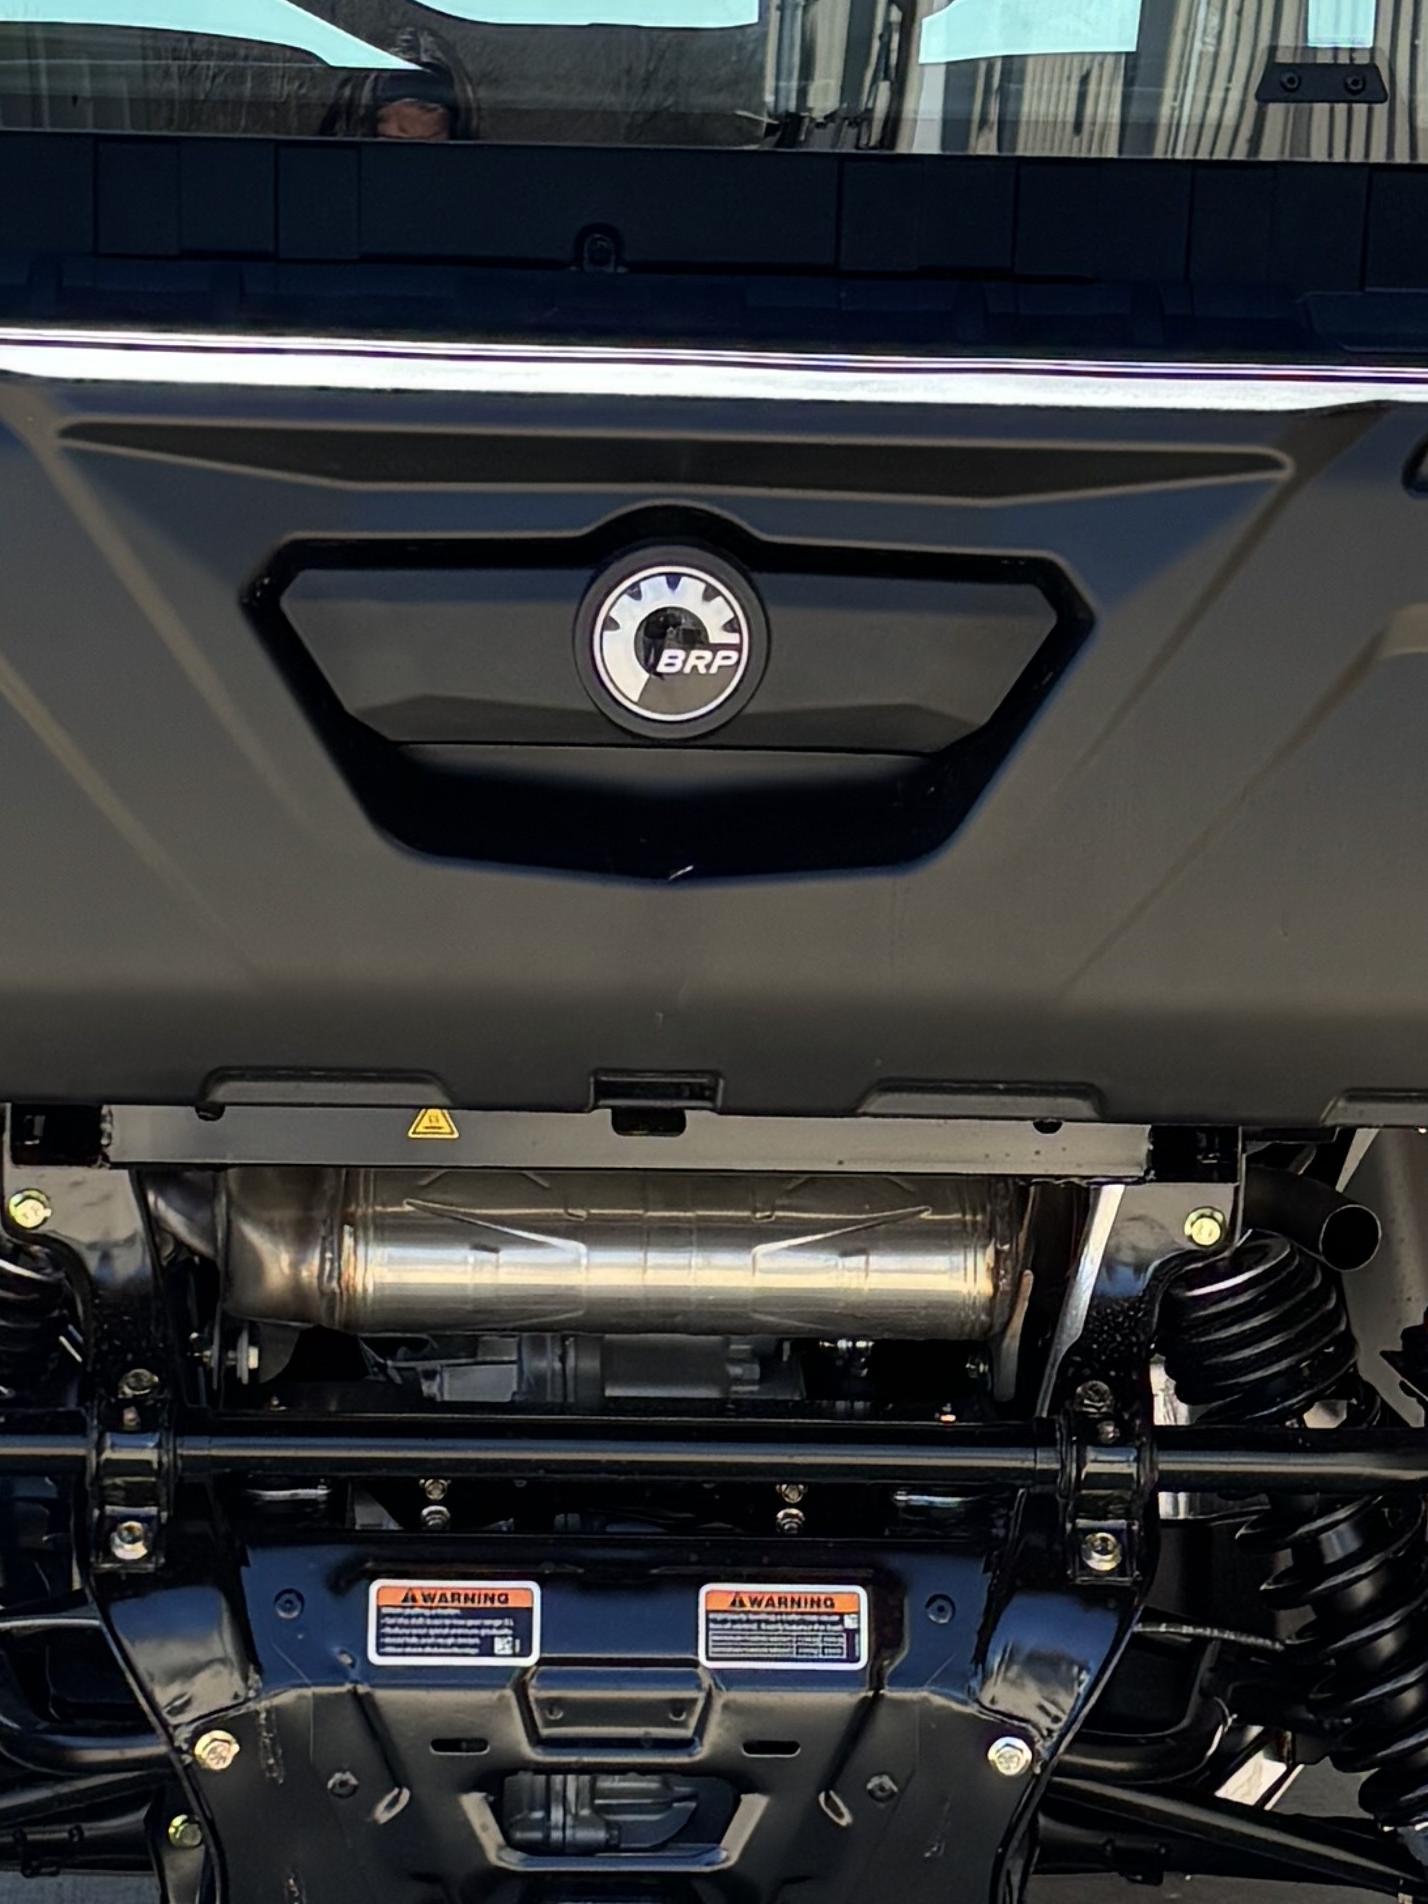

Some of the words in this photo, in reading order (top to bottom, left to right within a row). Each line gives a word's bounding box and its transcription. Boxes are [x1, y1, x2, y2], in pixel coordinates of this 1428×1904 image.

[655, 649, 740, 674] BRP
[421, 1592, 510, 1605] WARNING
[749, 1595, 835, 1609] WARNING
